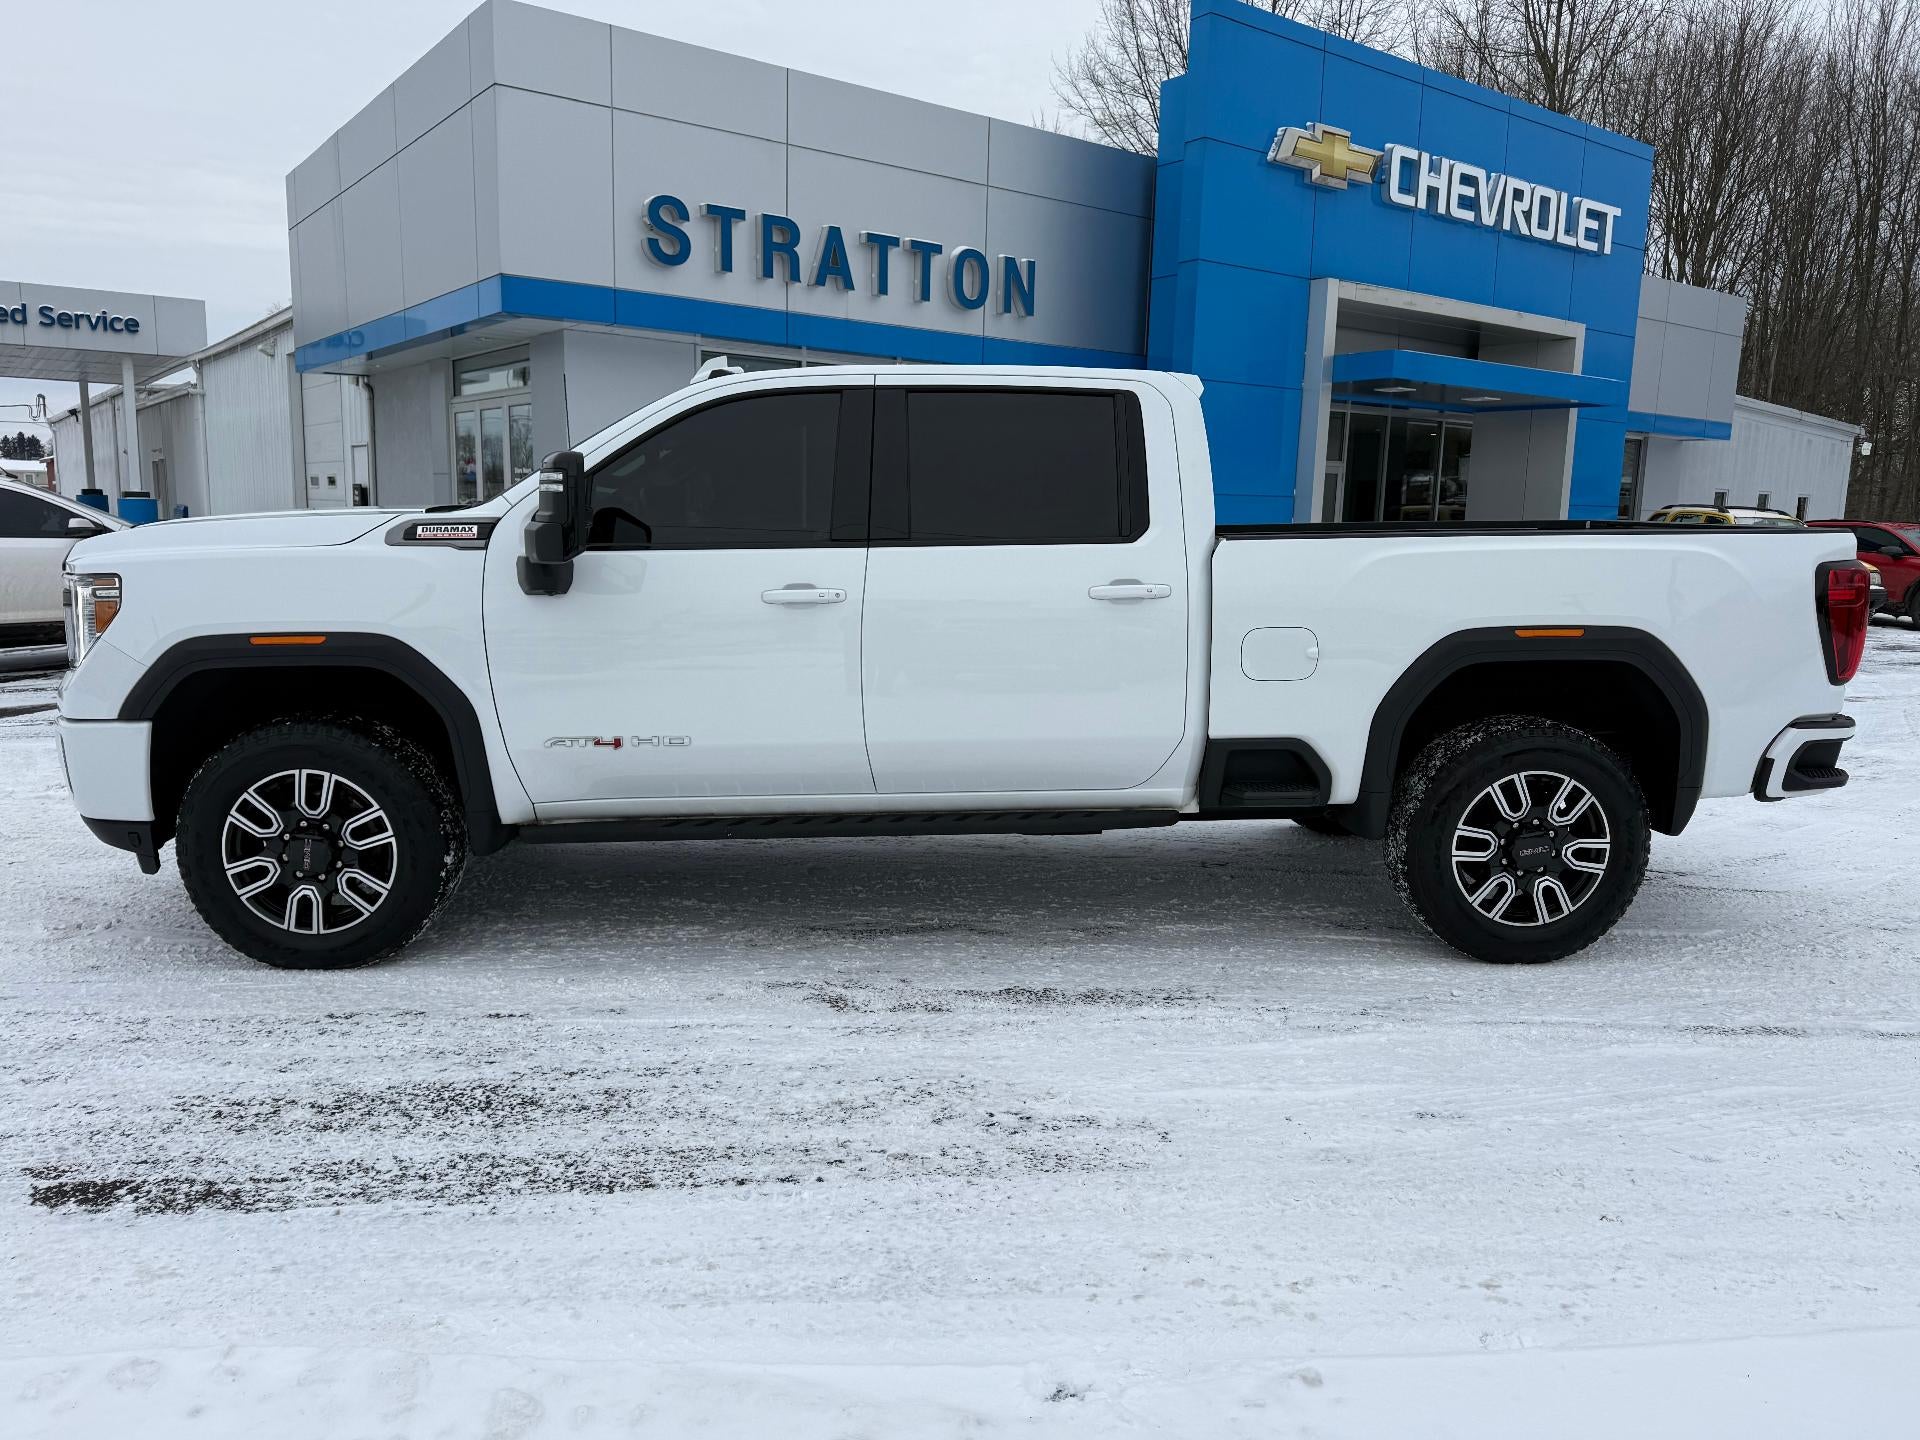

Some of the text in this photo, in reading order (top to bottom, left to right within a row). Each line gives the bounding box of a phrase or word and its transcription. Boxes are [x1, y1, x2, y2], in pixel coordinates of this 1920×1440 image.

[1384, 143, 1621, 255] CHEVROLET
[641, 194, 1036, 317] STRATTON
[39, 305, 140, 333] Service
[544, 735, 691, 750] AT4 HD
